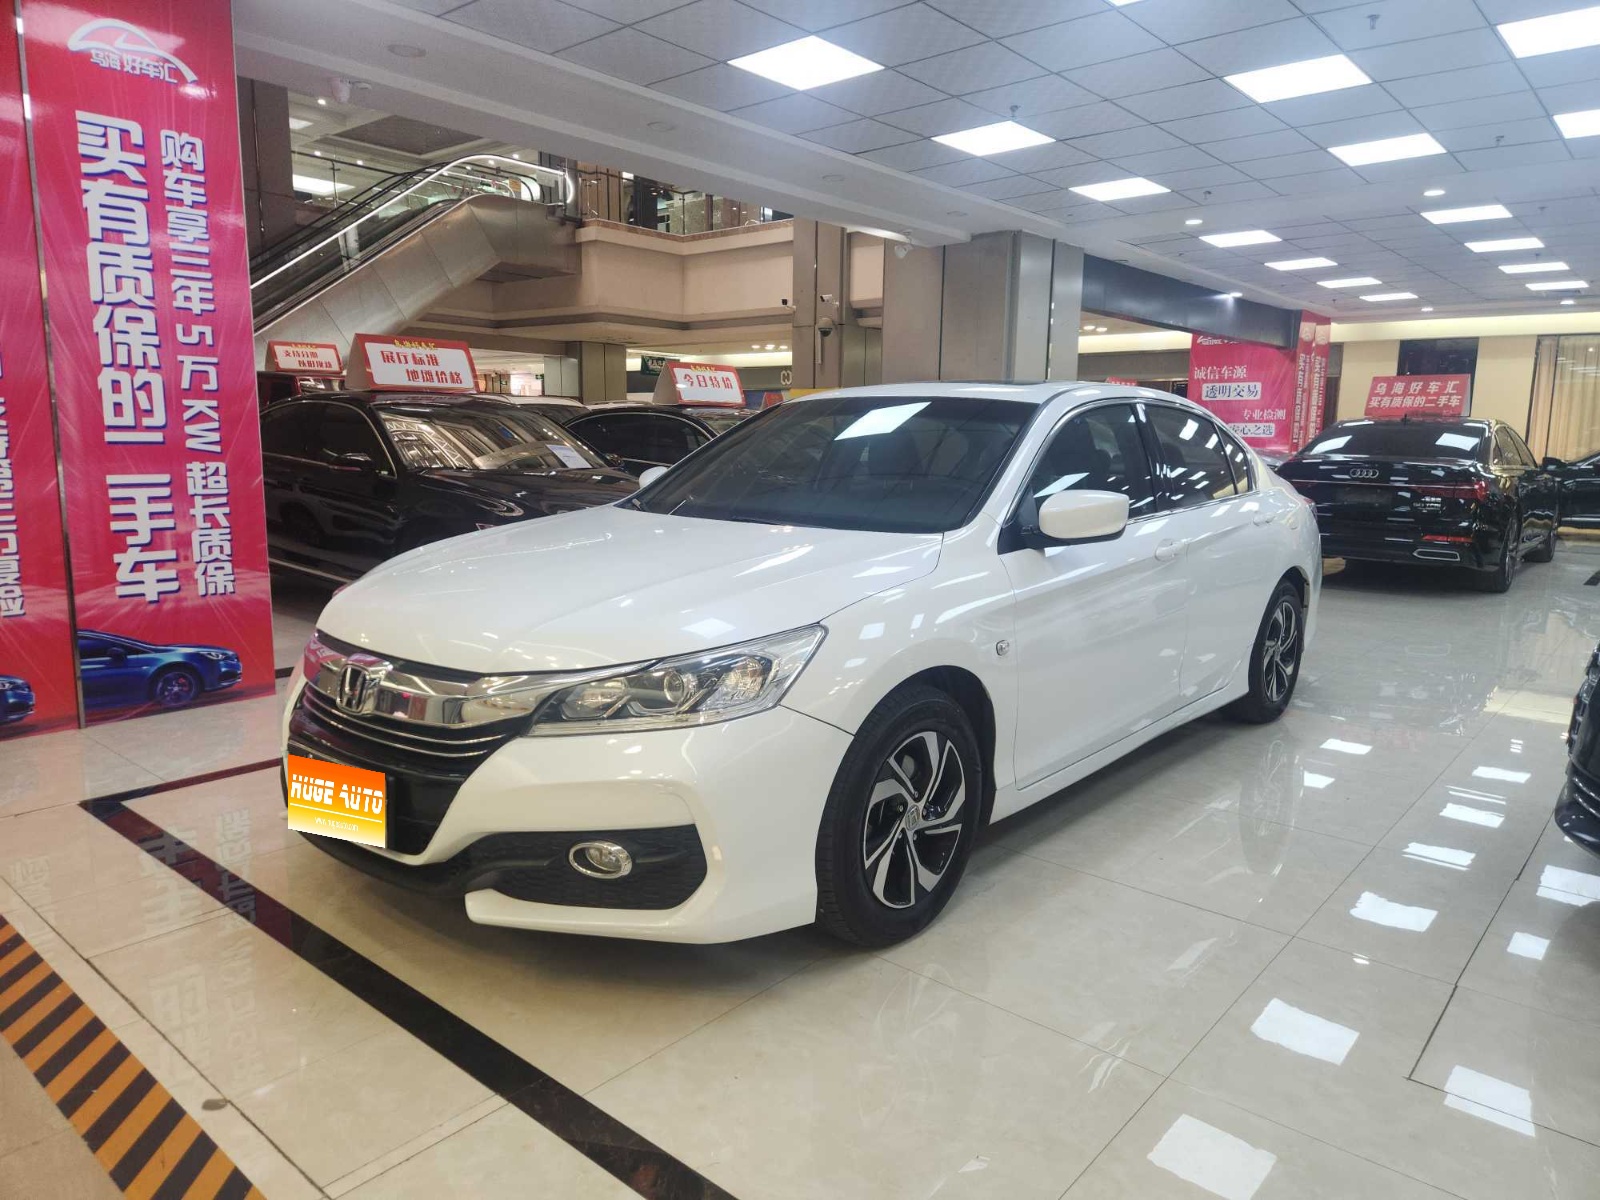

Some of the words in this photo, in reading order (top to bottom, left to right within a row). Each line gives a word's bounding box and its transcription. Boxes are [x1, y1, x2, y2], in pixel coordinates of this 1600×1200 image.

[75, 110, 181, 602] 买有质保的二手车
[1194, 365, 1247, 379] 诚信车源
[683, 373, 733, 389] 今日特价
[1374, 381, 1459, 395] 乌海好车汇
[1205, 384, 1258, 398] 透明交易
[1368, 396, 1461, 409] 买有质保的二手车
[1243, 408, 1286, 420] 专业检测
